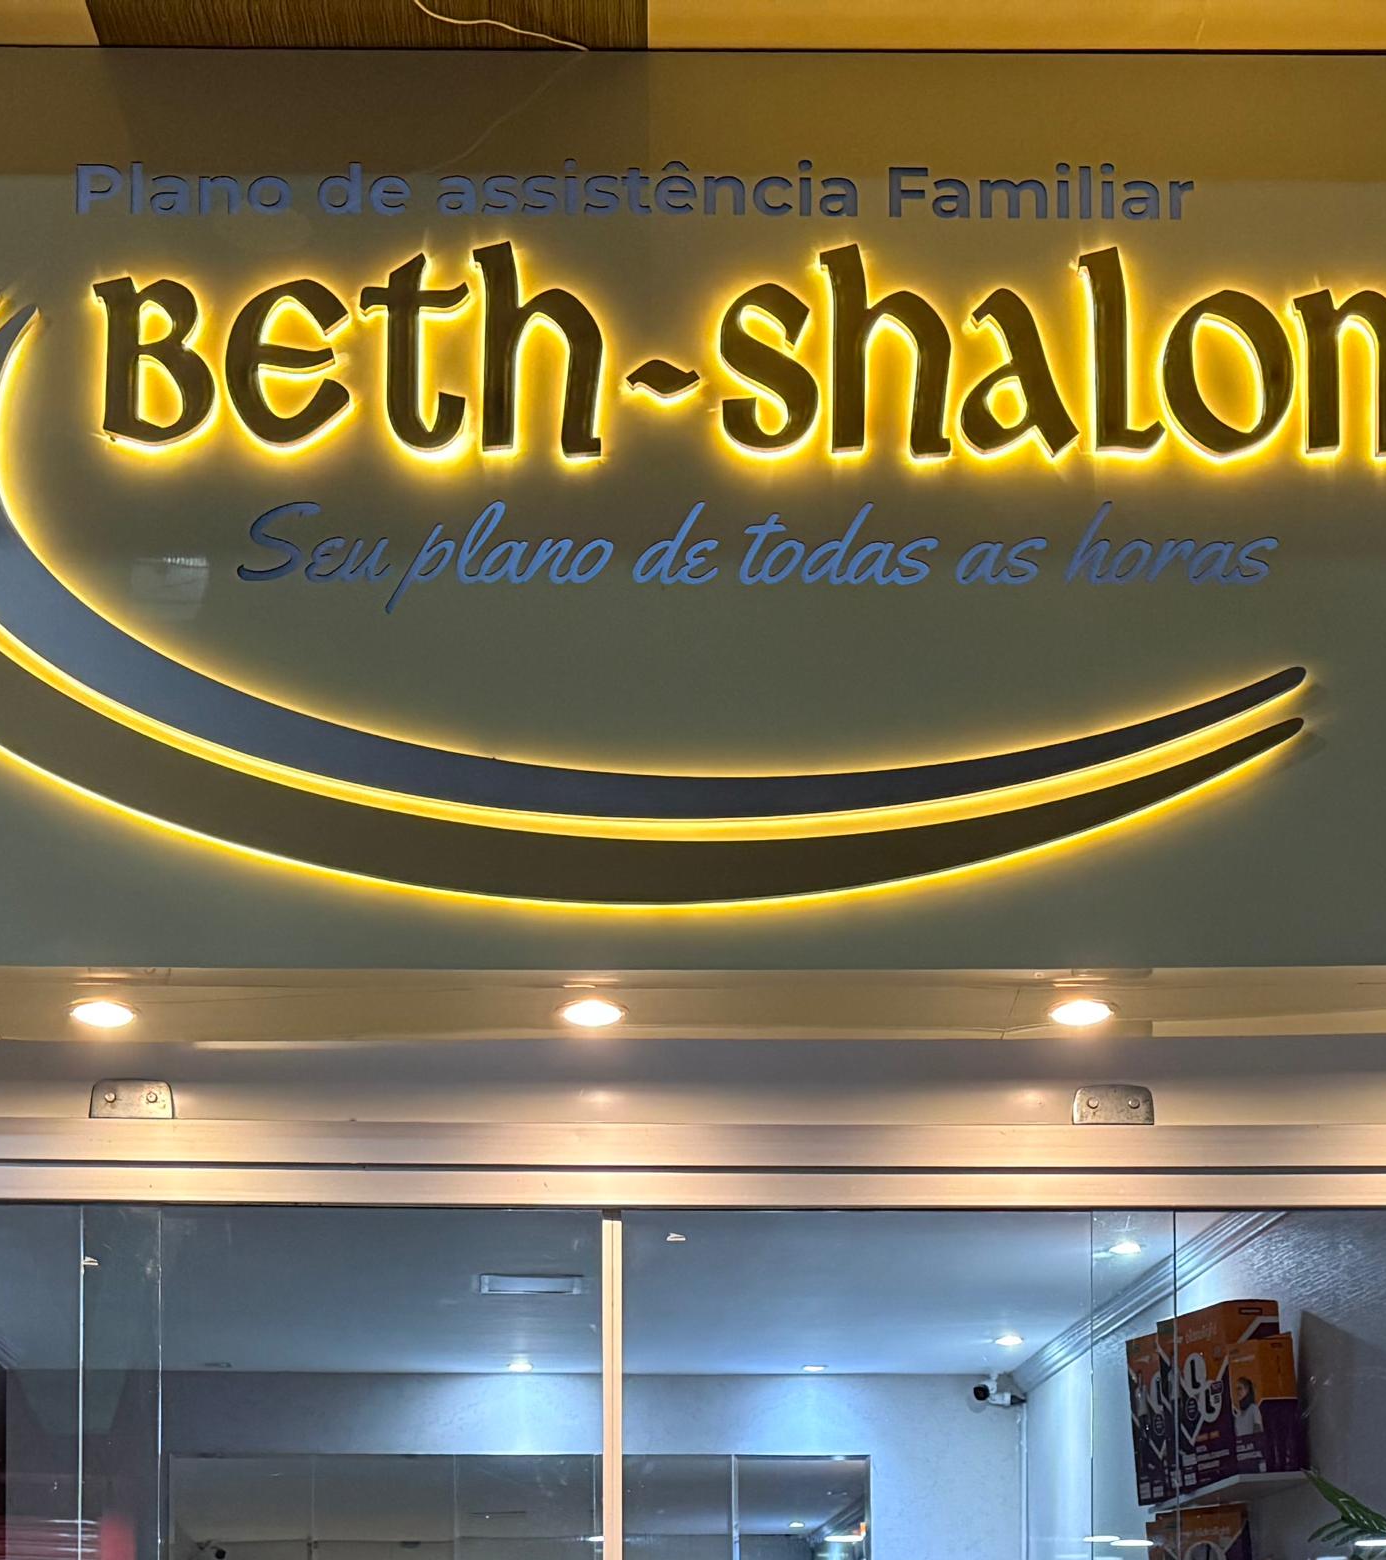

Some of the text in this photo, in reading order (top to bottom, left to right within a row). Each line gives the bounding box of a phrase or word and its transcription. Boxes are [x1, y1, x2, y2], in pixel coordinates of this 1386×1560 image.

[75, 157, 1195, 221] Plano de assistência Familiar
[236, 500, 1280, 615] Seu plano de todas as horas
